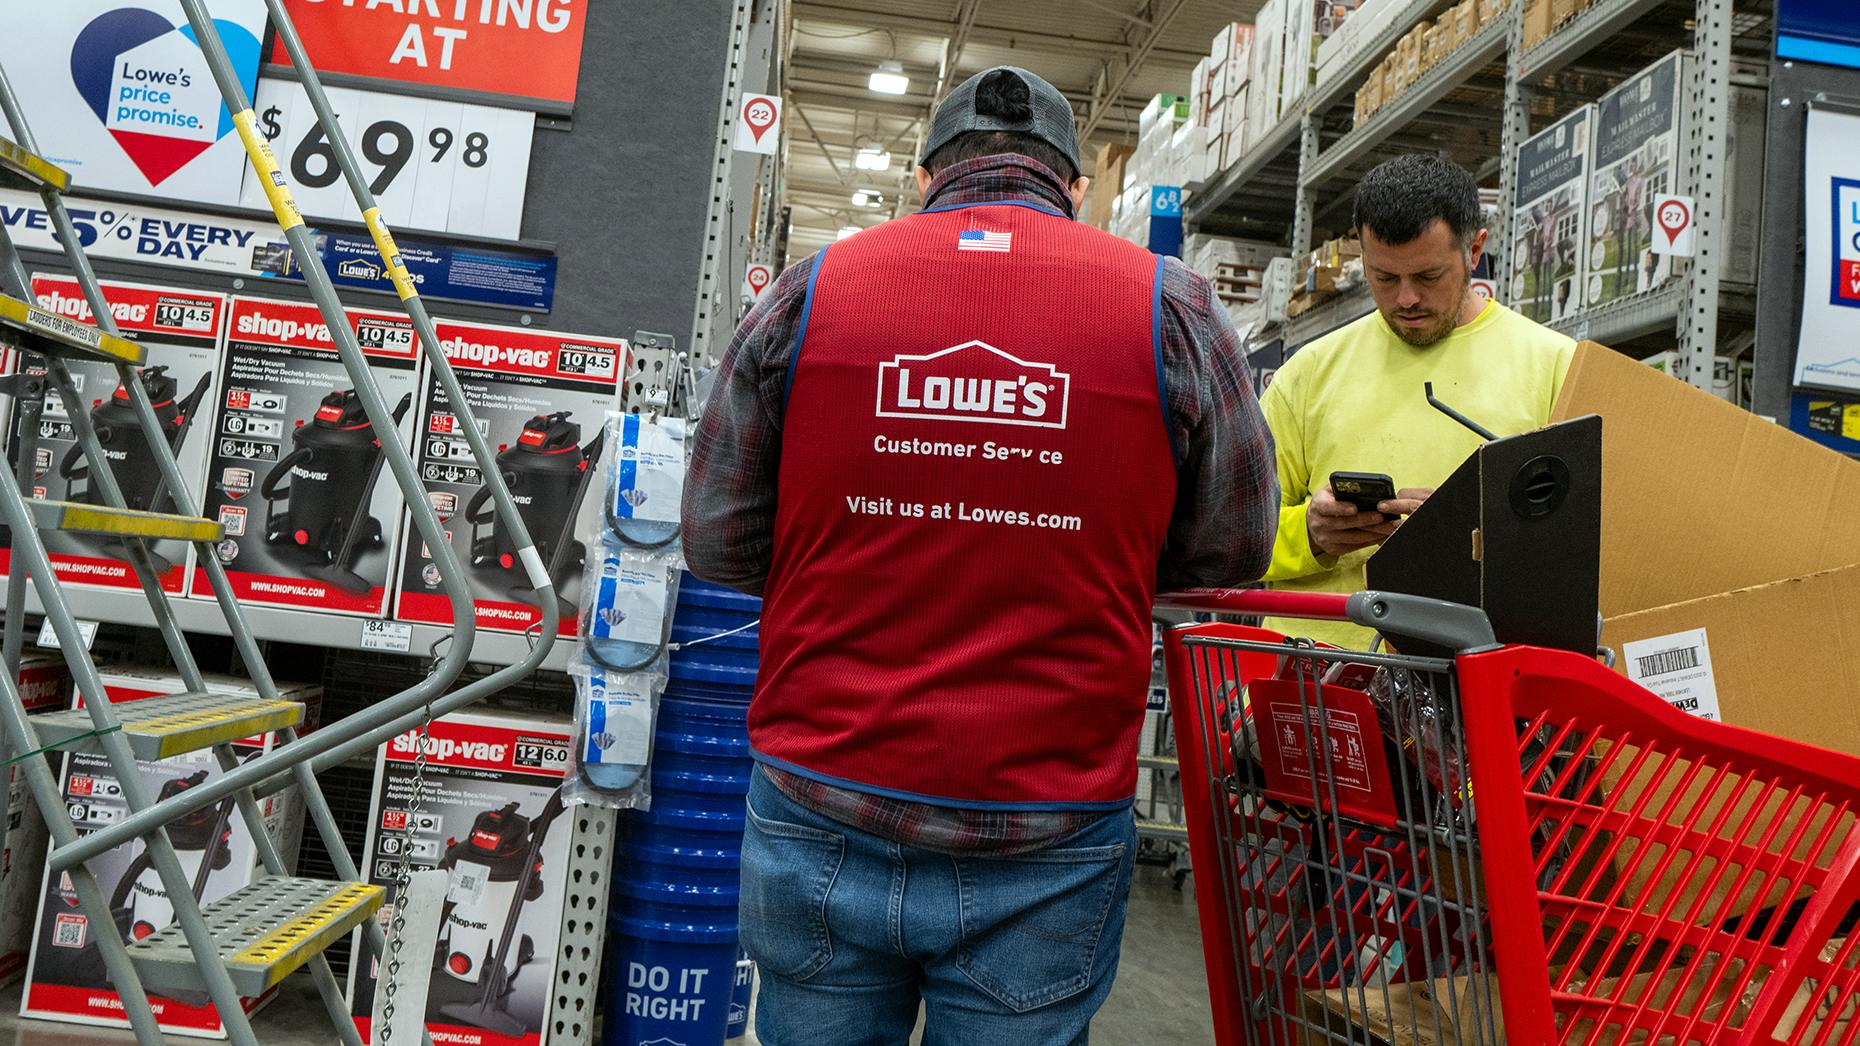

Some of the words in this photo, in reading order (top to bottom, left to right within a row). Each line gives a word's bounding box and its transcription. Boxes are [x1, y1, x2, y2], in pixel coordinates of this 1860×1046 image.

[389, 22, 468, 70] AT
[122, 62, 192, 87] Lowe's
[119, 84, 171, 105] price
[116, 105, 203, 129] promise.
[751, 109, 769, 120] 22
[1664, 211, 1682, 222] 27
[140, 218, 255, 248] EVERY
[136, 237, 209, 261] DAY
[753, 274, 764, 282] 24
[185, 309, 211, 322] 4.5
[361, 327, 382, 341] 10
[386, 331, 411, 344] 4.5
[233, 356, 259, 366] Wet/Dry
[261, 359, 286, 368] Vacuum
[587, 355, 611, 369] 4.5
[232, 363, 263, 373] Aspirateur
[264, 367, 279, 375] Pour
[230, 371, 264, 381] Aspiradora
[463, 383, 488, 392] Vacuum
[466, 391, 482, 399] Pour
[230, 420, 242, 430] LG
[433, 444, 445, 454] LG
[873, 434, 977, 459] Customer
[846, 495, 893, 516] Visit
[899, 503, 925, 518] us
[930, 502, 952, 520] at
[958, 502, 1082, 531] Lowes.com
[250, 581, 326, 598] WWW.SHOPVAC.COM
[544, 748, 568, 762] 6.0
[420, 787, 436, 795] Pour
[421, 795, 437, 803] Para
[71, 808, 82, 816] LG
[386, 841, 397, 851] LG
[627, 961, 670, 993] DO
[679, 968, 709, 994] IT
[625, 992, 706, 1021] RIGHT
